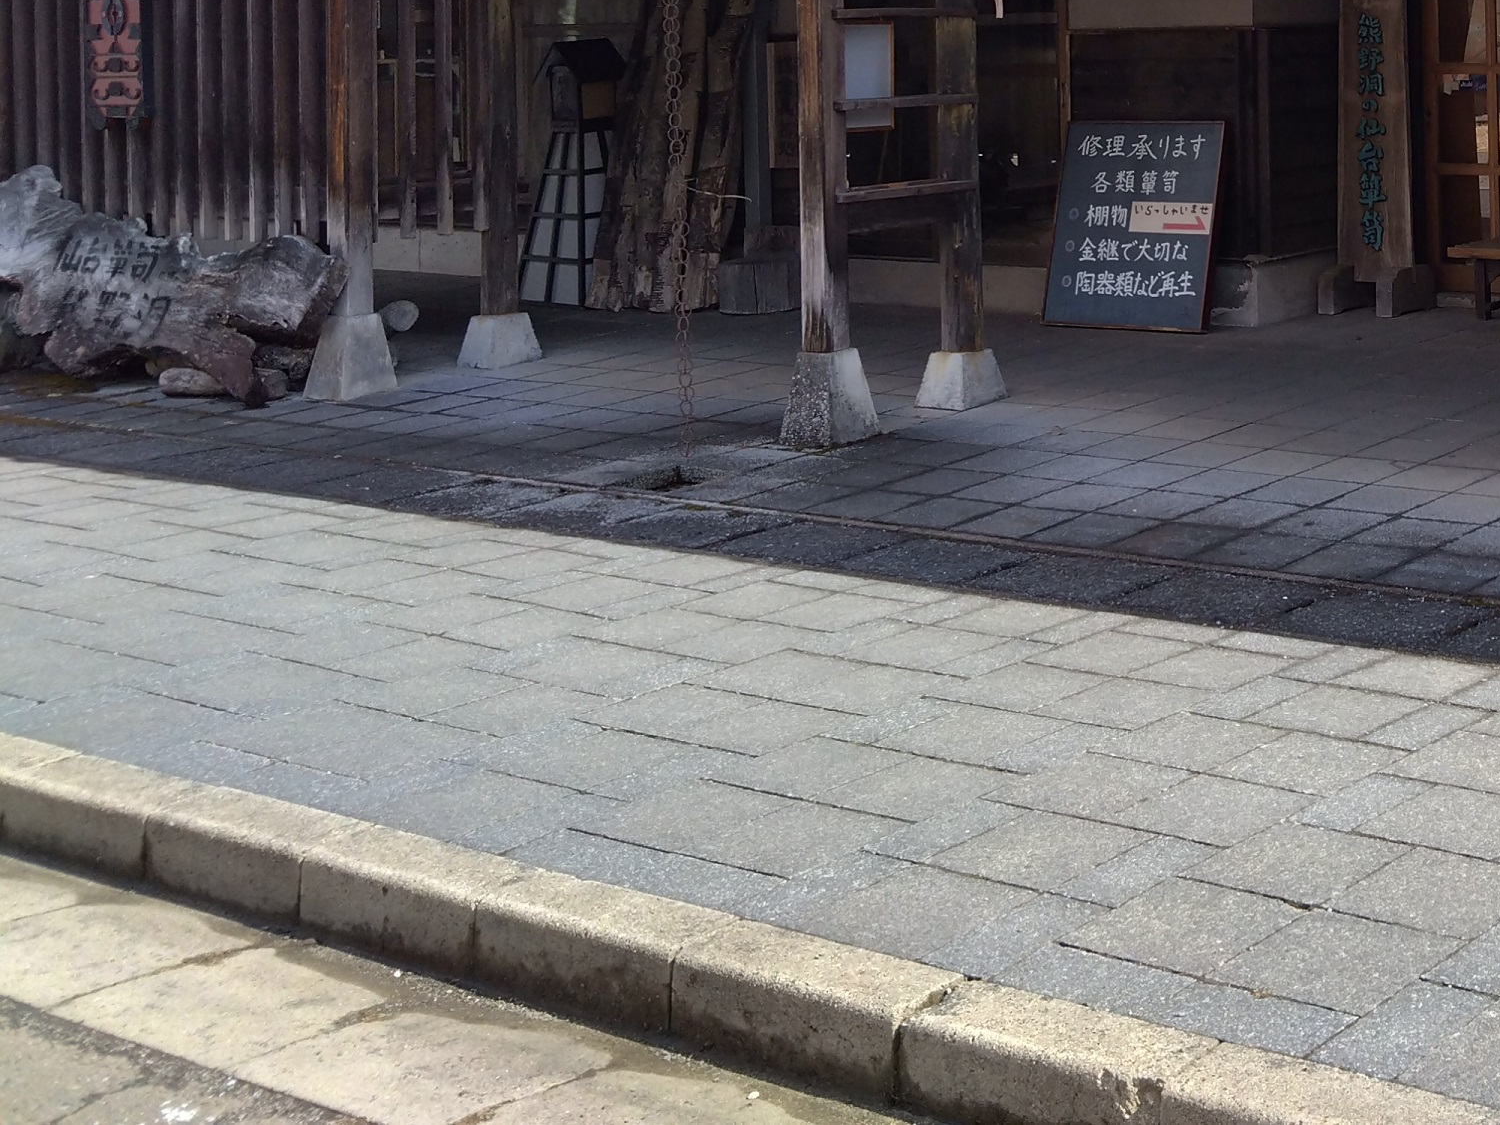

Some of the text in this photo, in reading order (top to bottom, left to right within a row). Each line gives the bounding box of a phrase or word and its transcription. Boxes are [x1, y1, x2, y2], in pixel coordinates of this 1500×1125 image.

[1078, 134, 1206, 160] 修理承ります
[1083, 204, 1128, 228] 棚物
[1134, 204, 1209, 216] いらっしゃいませ
[1078, 237, 1189, 262] 金継で大切な
[1075, 270, 1196, 297] 陶器類など再生
